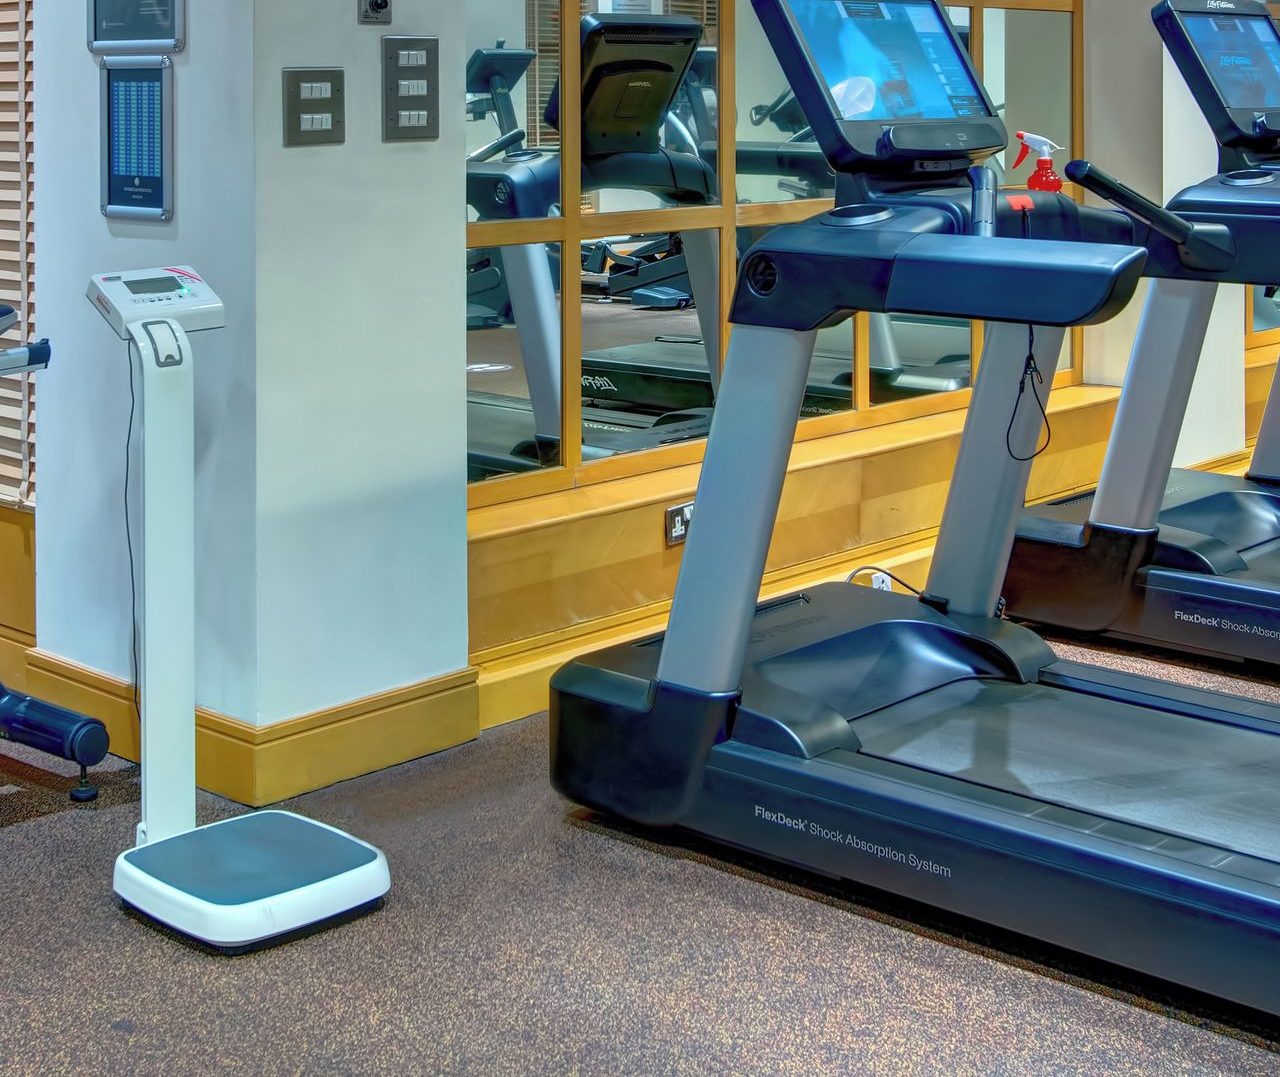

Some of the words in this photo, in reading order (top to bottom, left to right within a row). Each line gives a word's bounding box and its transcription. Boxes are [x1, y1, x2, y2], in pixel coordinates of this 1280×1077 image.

[1221, 619, 1250, 633] Shock
[809, 822, 844, 844] Shock
[845, 834, 906, 863] Absorption
[908, 854, 951, 878] System
